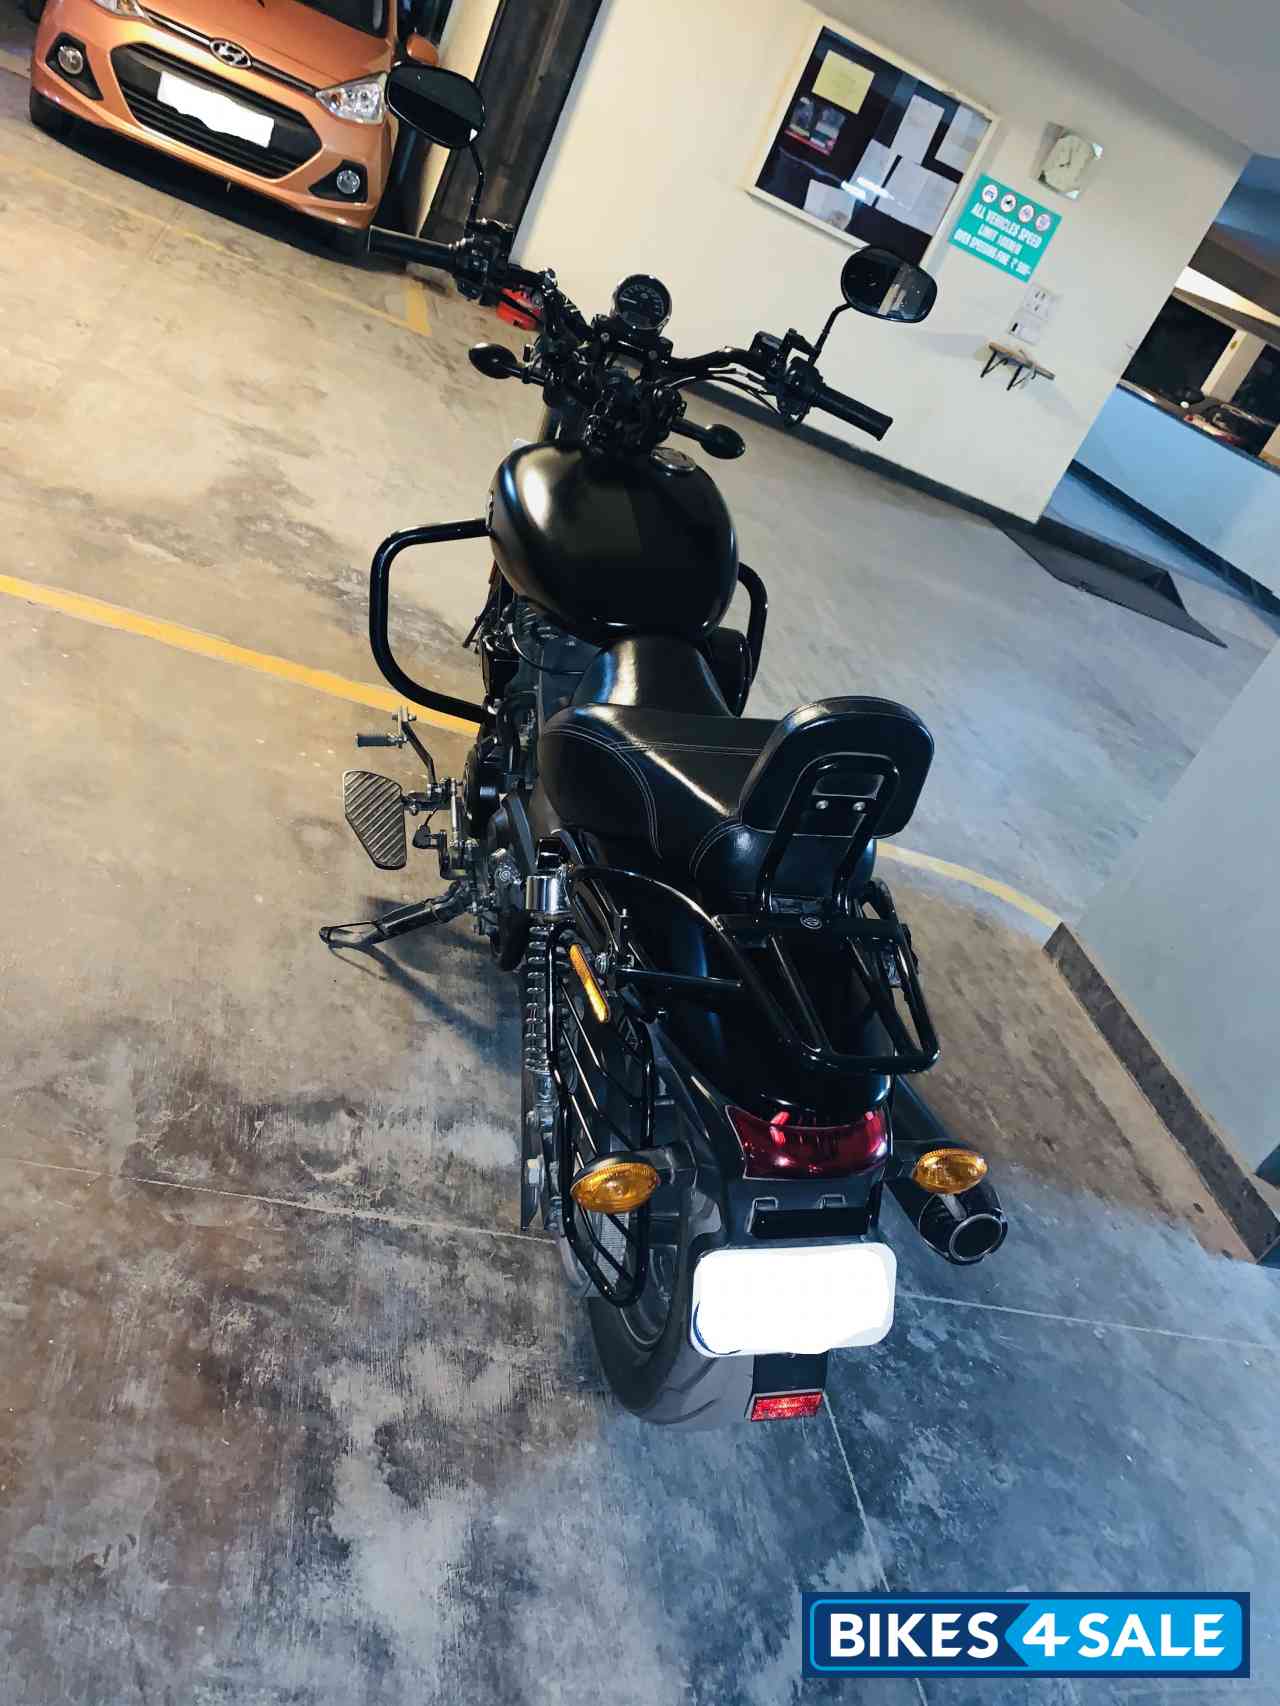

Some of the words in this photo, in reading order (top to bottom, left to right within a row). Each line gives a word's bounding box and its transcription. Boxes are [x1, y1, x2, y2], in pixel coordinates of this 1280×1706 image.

[970, 202, 987, 219] ALL
[985, 209, 1021, 237] VEHICLES
[1017, 227, 1042, 249] SPEED
